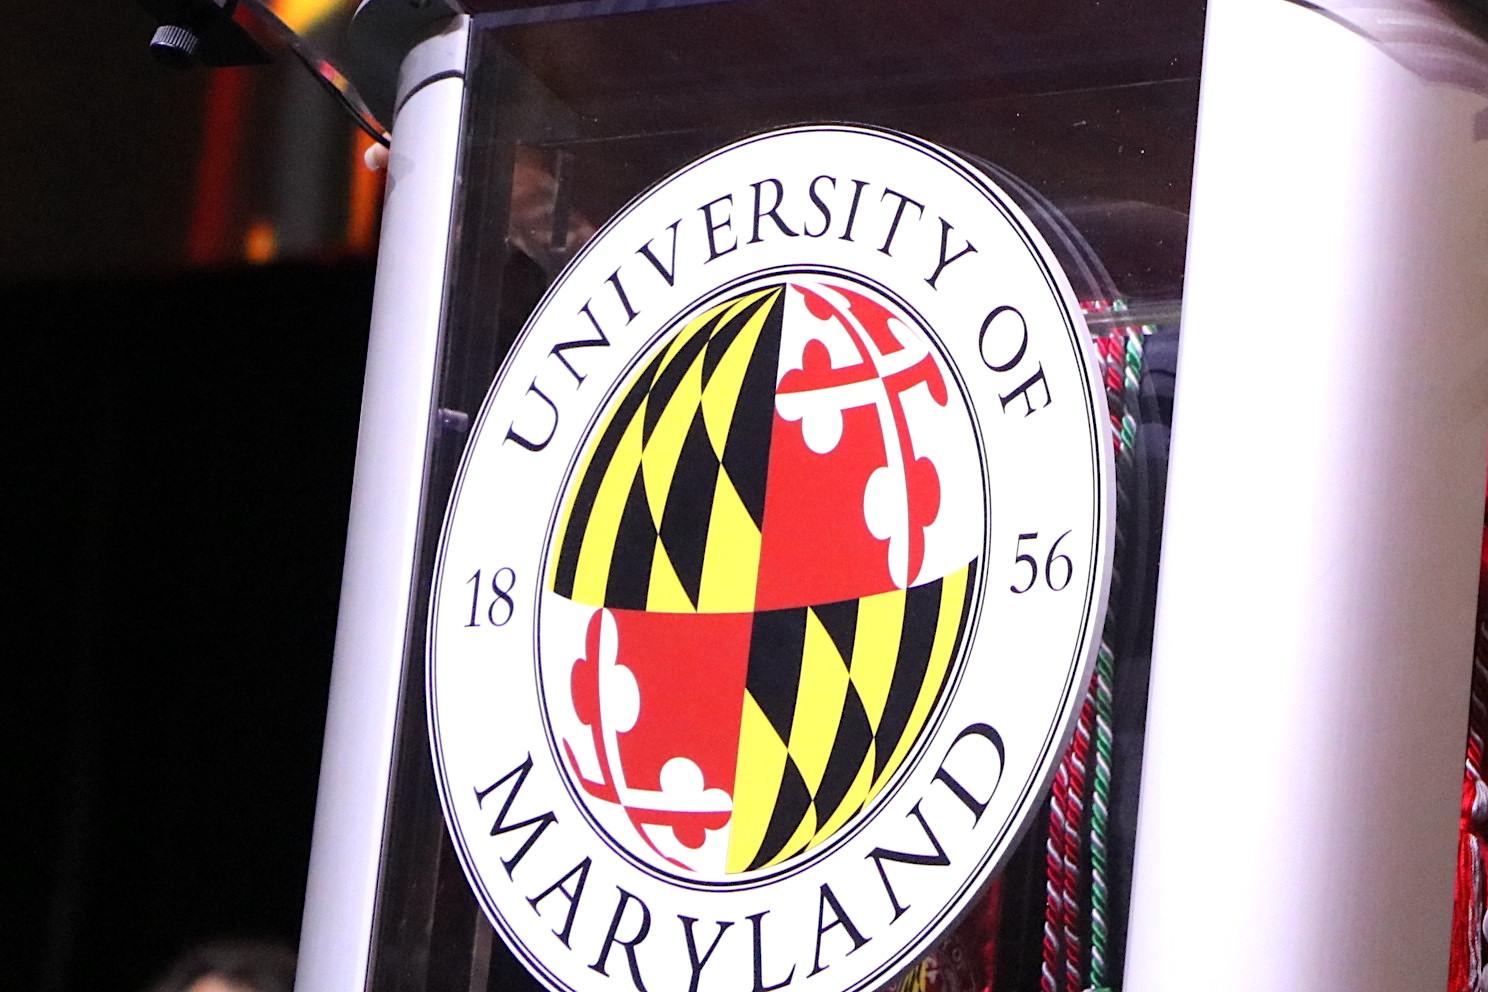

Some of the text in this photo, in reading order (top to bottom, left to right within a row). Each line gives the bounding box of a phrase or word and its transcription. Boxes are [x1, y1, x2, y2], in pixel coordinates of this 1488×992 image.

[504, 174, 1053, 453] UNIVERSITY OF
[463, 530, 1074, 628] 18 56
[474, 721, 1007, 992] MARYLAND
